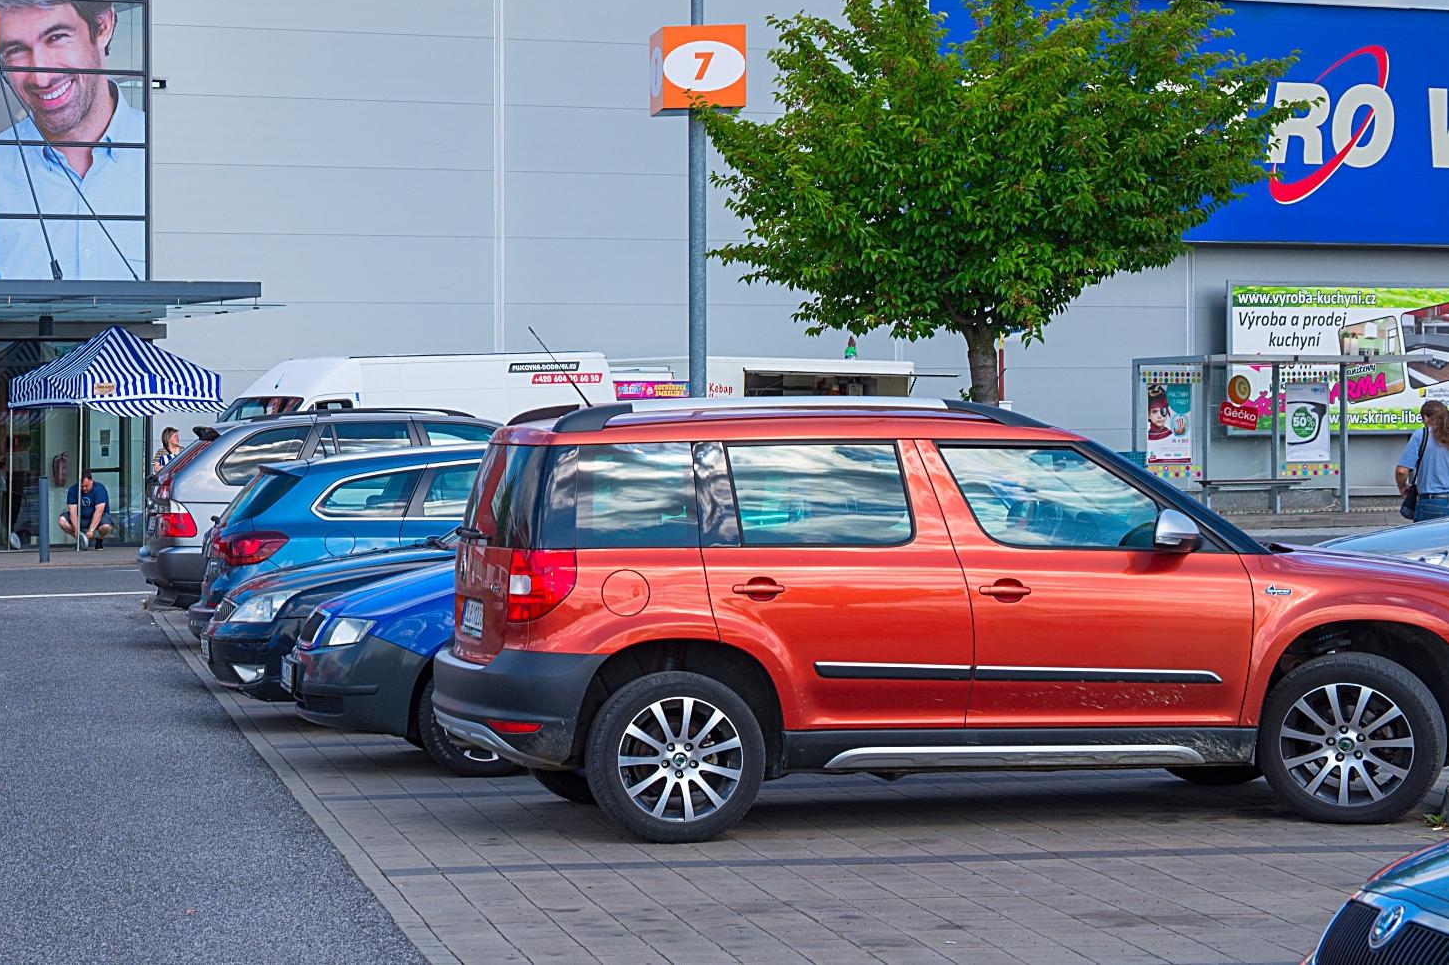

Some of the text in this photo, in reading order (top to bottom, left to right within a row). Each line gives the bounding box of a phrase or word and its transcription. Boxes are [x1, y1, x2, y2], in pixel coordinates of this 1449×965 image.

[695, 52, 714, 80] 7
[1238, 291, 1377, 307] www.vyroba-kuchyni.cz
[1238, 311, 1347, 329] Výroba a prodej
[1268, 332, 1321, 350] kuchyní
[534, 374, 552, 383] +420
[553, 374, 568, 382] 604
[579, 374, 589, 382] 60
[590, 374, 600, 382] 50
[709, 382, 734, 395] Kebap
[1223, 406, 1257, 421] Géčko
